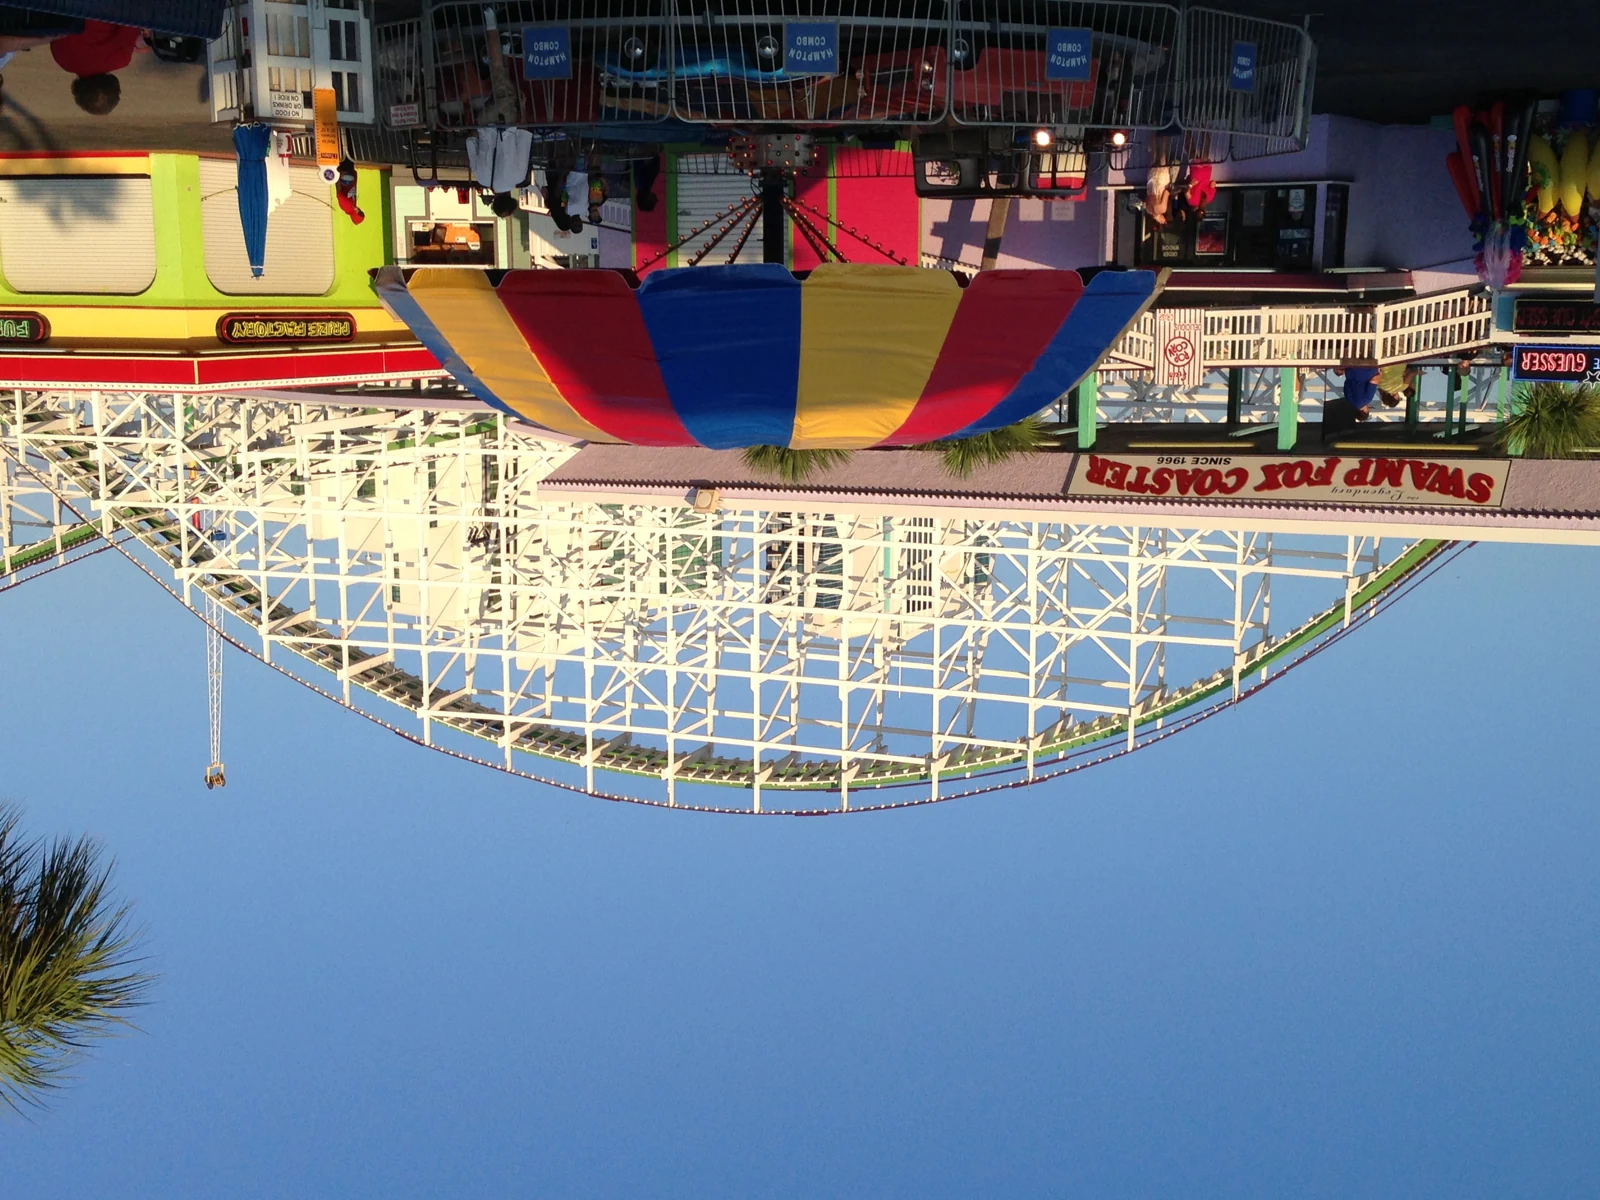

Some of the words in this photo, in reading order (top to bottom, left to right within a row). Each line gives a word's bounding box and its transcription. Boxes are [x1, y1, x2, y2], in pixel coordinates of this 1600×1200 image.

[533, 41, 560, 52] COMBO
[796, 36, 826, 47] COMBO
[1057, 42, 1082, 52] COMBO
[528, 52, 567, 66] HAMPTON
[788, 48, 834, 62] HAMPTON
[1050, 53, 1087, 68] HAMPTON
[0, 319, 30, 338] FU
[232, 321, 306, 338] FACTORY
[308, 321, 350, 336] PRIZE
[1168, 342, 1188, 357] CORN
[1174, 350, 1190, 363] POP
[1521, 352, 1586, 372] GUESSER
[1156, 456, 1187, 465] 1966
[1190, 456, 1232, 465] SINCE
[1085, 454, 1249, 496] COASTER
[1253, 457, 1342, 492] FOX
[1343, 457, 1494, 504] SWAMP
[1330, 487, 1403, 500] Legendary
